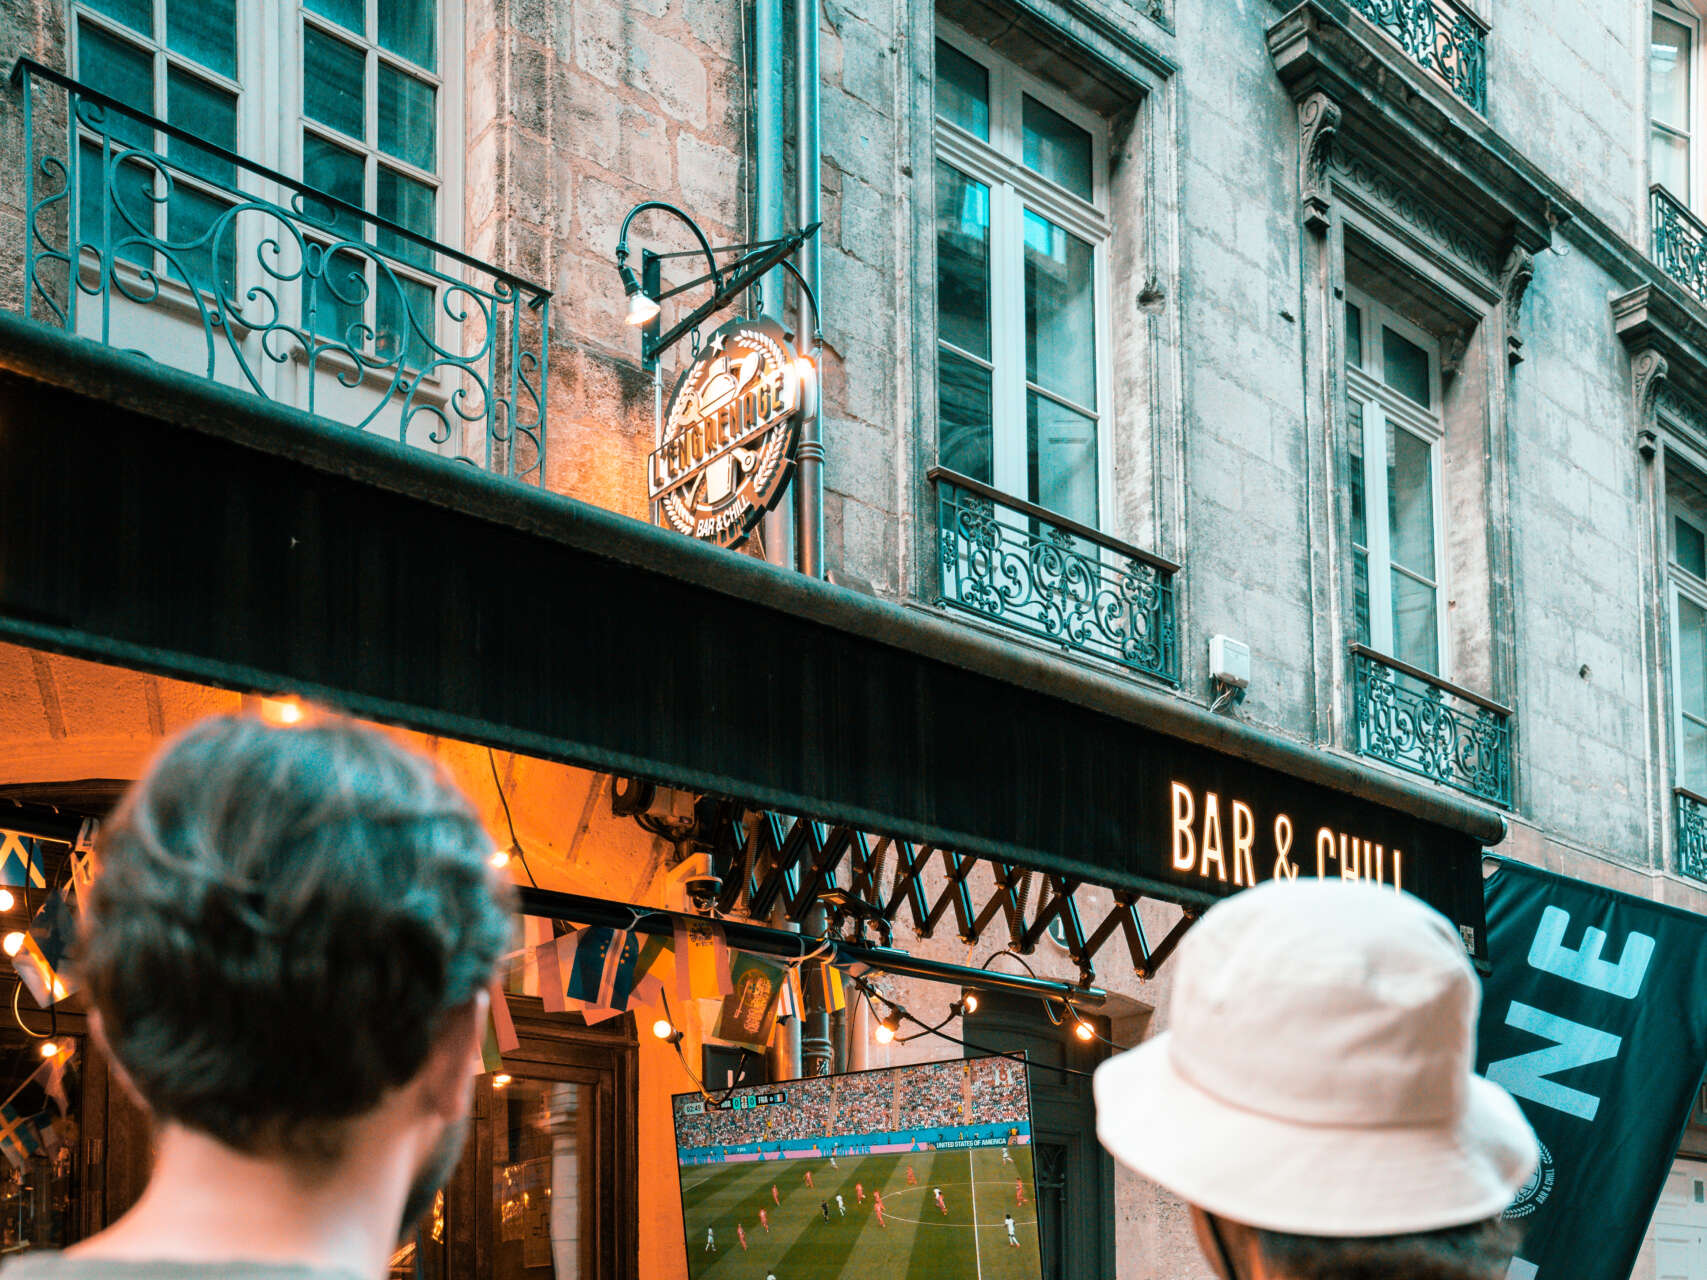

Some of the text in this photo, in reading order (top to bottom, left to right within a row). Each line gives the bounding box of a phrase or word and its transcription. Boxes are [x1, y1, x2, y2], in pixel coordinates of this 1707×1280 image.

[695, 494, 751, 537] BAR & CHILL
[1171, 780, 1255, 887] BAR
[1273, 813, 1299, 885] &
[936, 1140, 955, 1149] UNITED
[955, 1140, 974, 1148] STATES
[982, 1138, 1007, 1146] AMERICA
